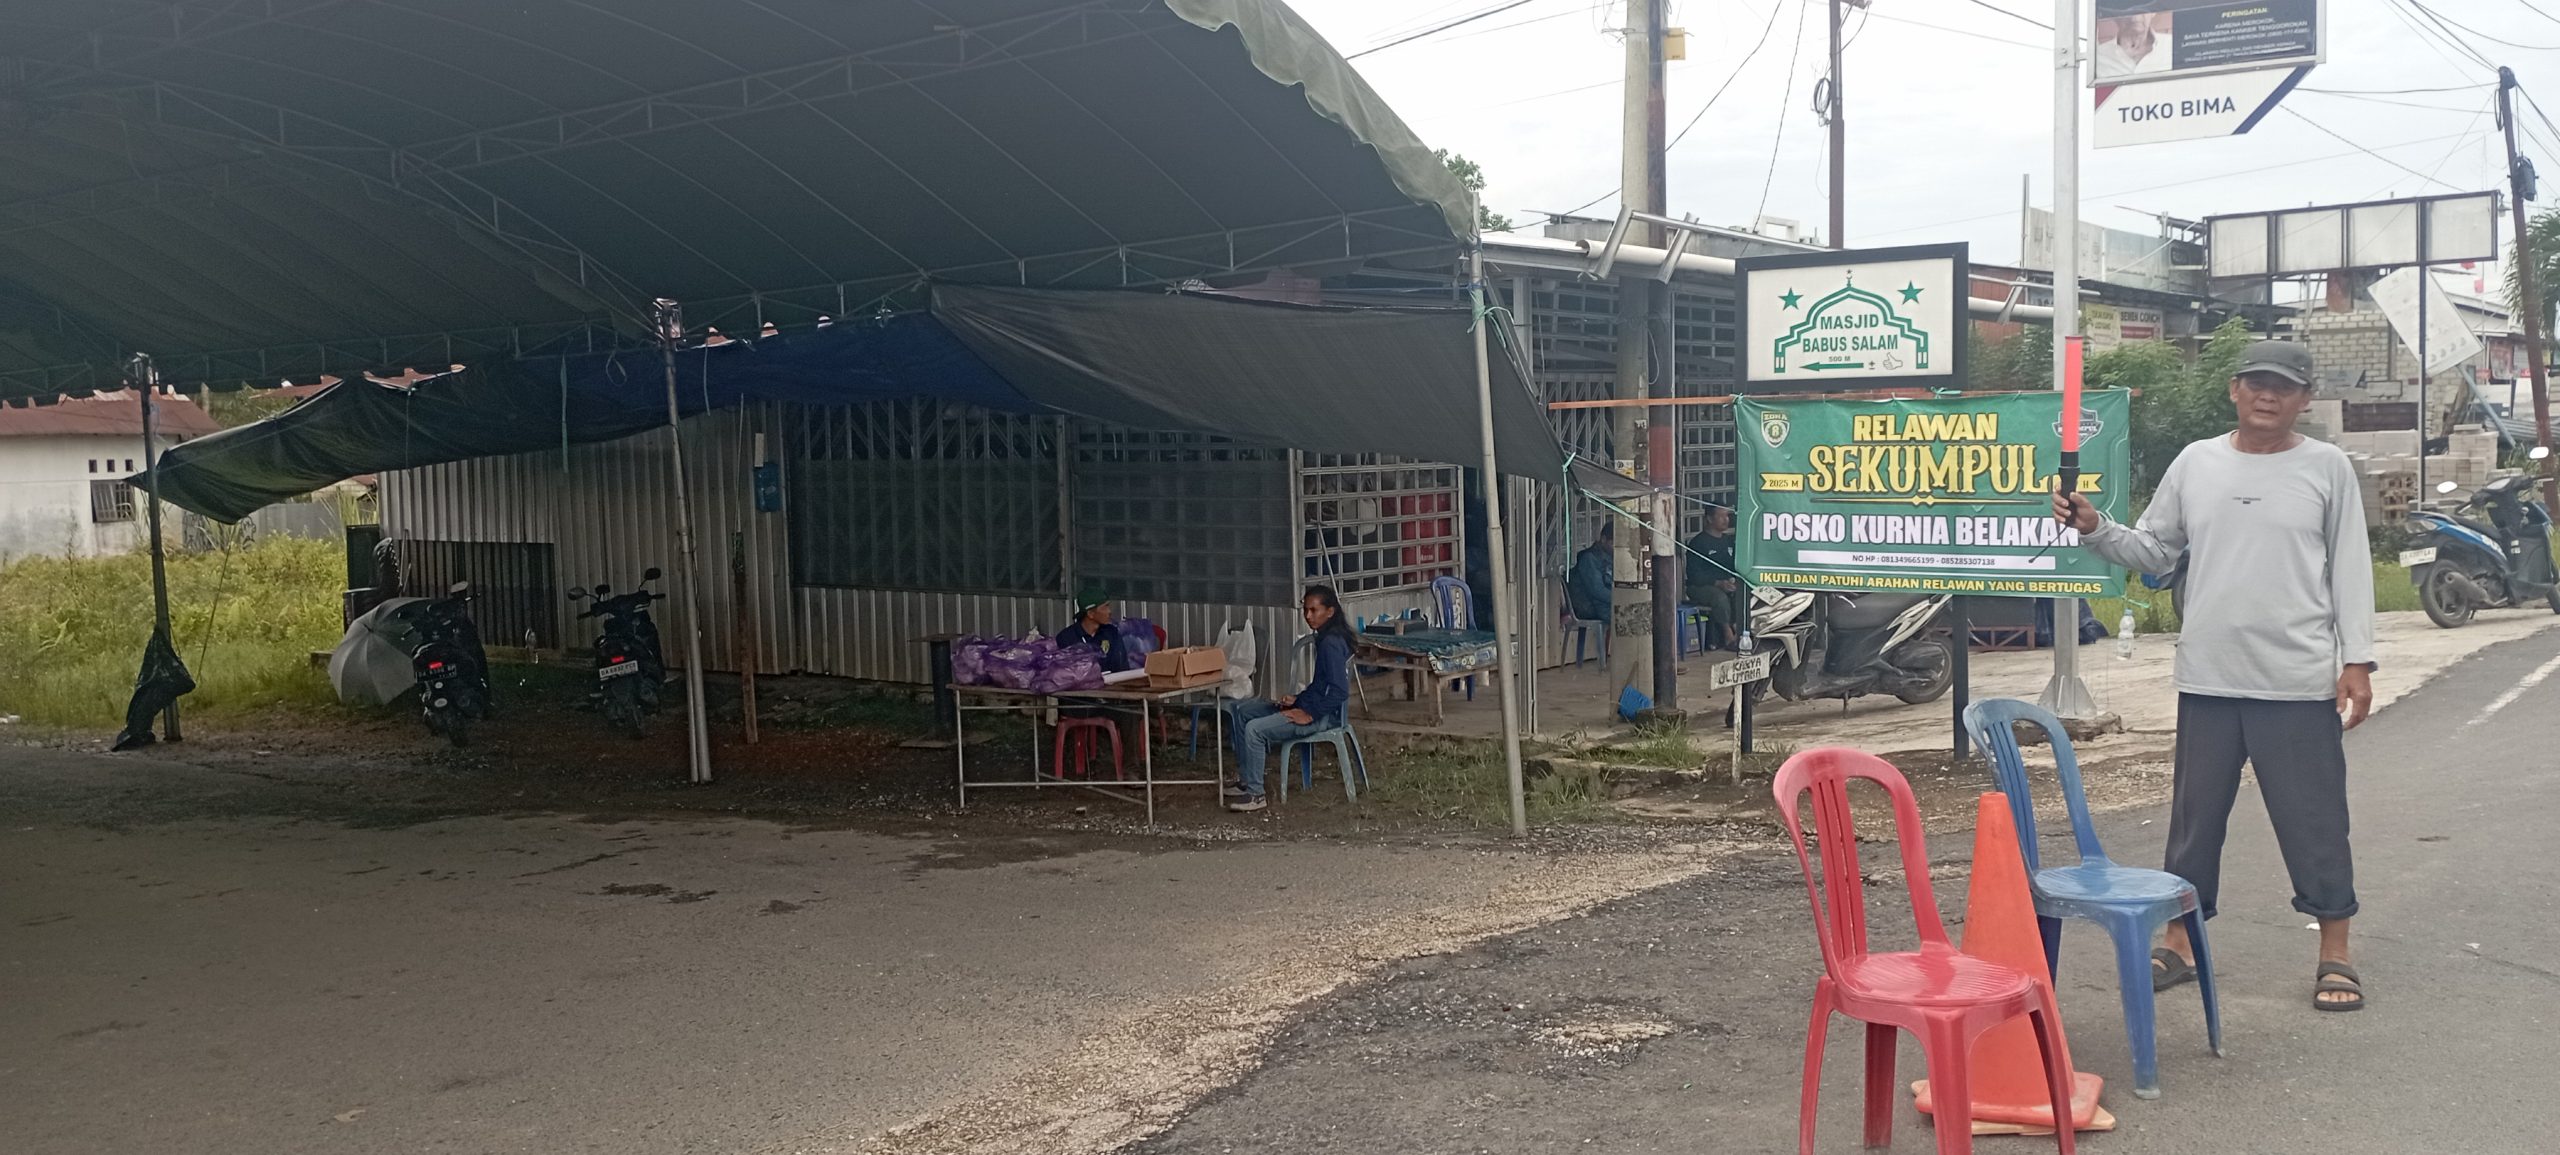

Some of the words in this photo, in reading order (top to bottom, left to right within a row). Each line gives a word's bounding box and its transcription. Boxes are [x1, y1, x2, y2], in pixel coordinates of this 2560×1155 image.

[2118, 103, 2173, 123] TOKO
[2181, 96, 2236, 117] BIMA
[1820, 314, 1879, 330] MASJID
[1802, 337, 1847, 353] BABUS
[1851, 334, 1898, 351] SALAM
[1853, 413, 1998, 441] RELAWAN
[1807, 444, 2049, 493] SEKUMPUL
[1769, 479, 1789, 488] 2025
[1791, 479, 1799, 488] M
[2083, 480, 2089, 488] H
[1762, 512, 1846, 543] POSKO
[1851, 515, 1950, 545] KURNIA
[1955, 516, 2084, 547] BELAKAN
[1759, 572, 1791, 583] IKUTI
[1794, 574, 1818, 584] DAN
[1821, 575, 1864, 586] PATUHI
[1867, 577, 1920, 589] ARAHAN
[1922, 579, 1985, 591] RELAWAN
[1988, 581, 2025, 592] YANG
[2029, 582, 2102, 594] BERTUGAS
